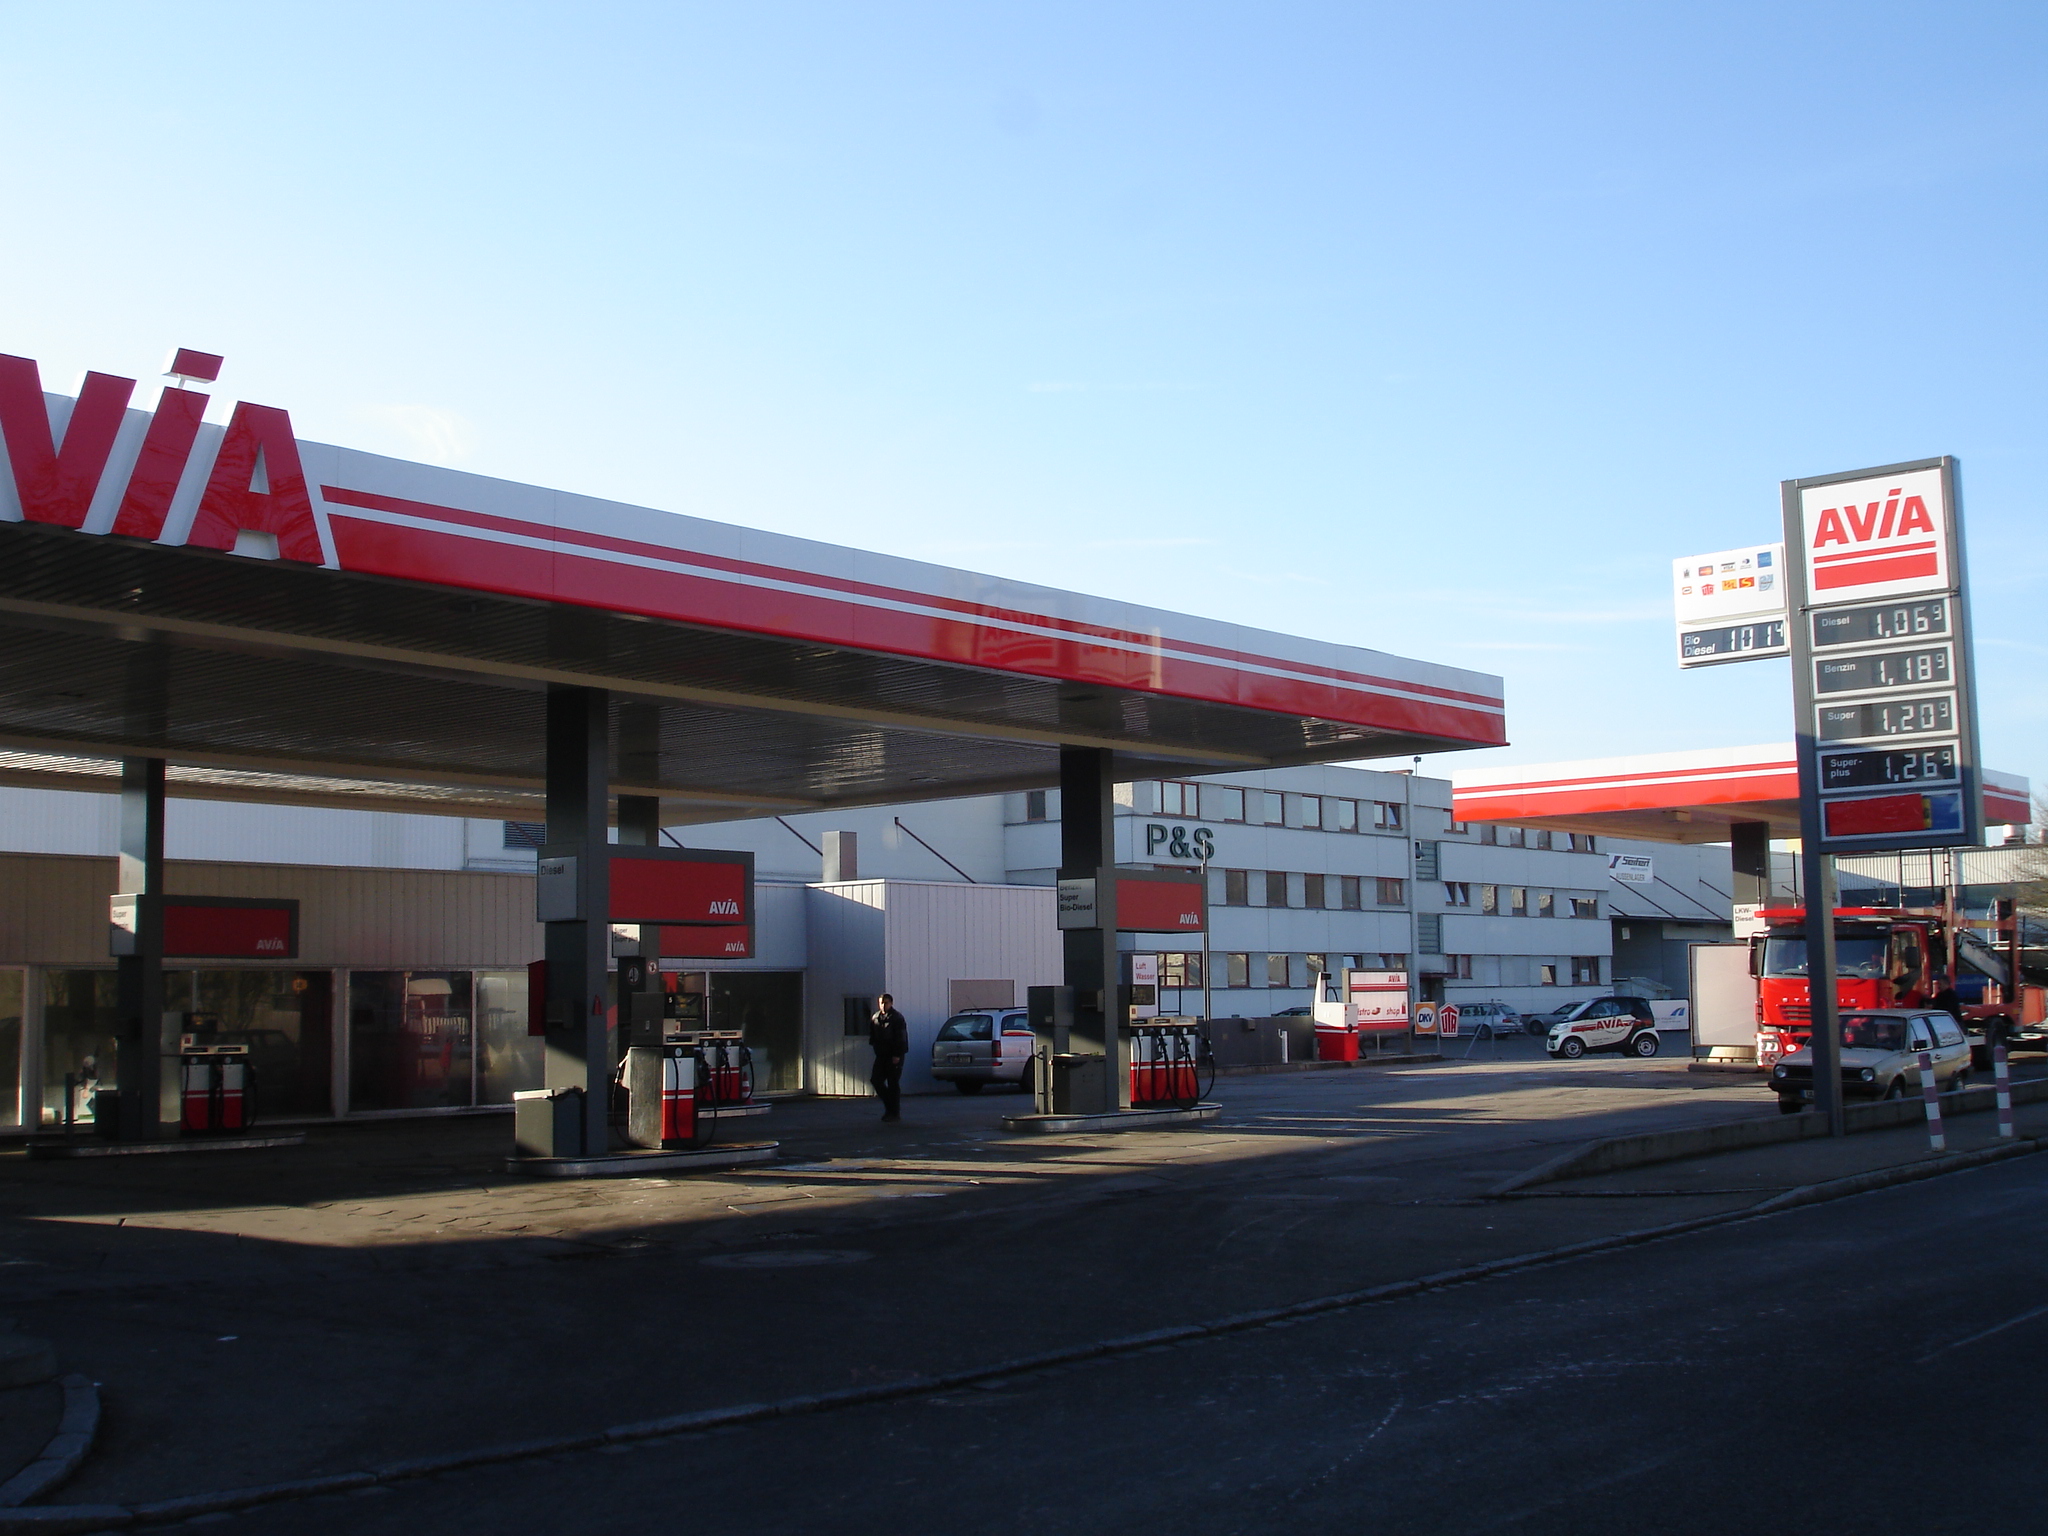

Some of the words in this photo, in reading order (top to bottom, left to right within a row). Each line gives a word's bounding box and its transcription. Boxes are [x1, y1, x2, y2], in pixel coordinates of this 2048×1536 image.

[1813, 488, 1935, 548] AVIA
[1821, 615, 1850, 627] Diesel
[1684, 635, 1701, 646] Bio
[1684, 643, 1715, 657] Diesel
[1824, 663, 1856, 674] Benzin
[1827, 711, 1855, 721] Super
[1830, 758, 1862, 769] Super-
[1830, 768, 1850, 779] plus
[1147, 823, 1215, 860] P&S
[540, 864, 565, 876] Diesel
[1060, 893, 1079, 902] Super
[709, 898, 739, 915] AVIA
[1060, 903, 1093, 912] Bio-Diesel
[1179, 911, 1199, 925] AVIA
[256, 937, 284, 950] AVIA
[725, 940, 745, 952] AVIA
[1135, 962, 1147, 970] Luft
[1135, 972, 1155, 980] Wasser
[1358, 1008, 1371, 1016] istro
[1386, 1007, 1400, 1017] shop
[1418, 1013, 1434, 1023] DKV
[1441, 1008, 1457, 1034] UTA
[1595, 1016, 1625, 1031] AVIA
